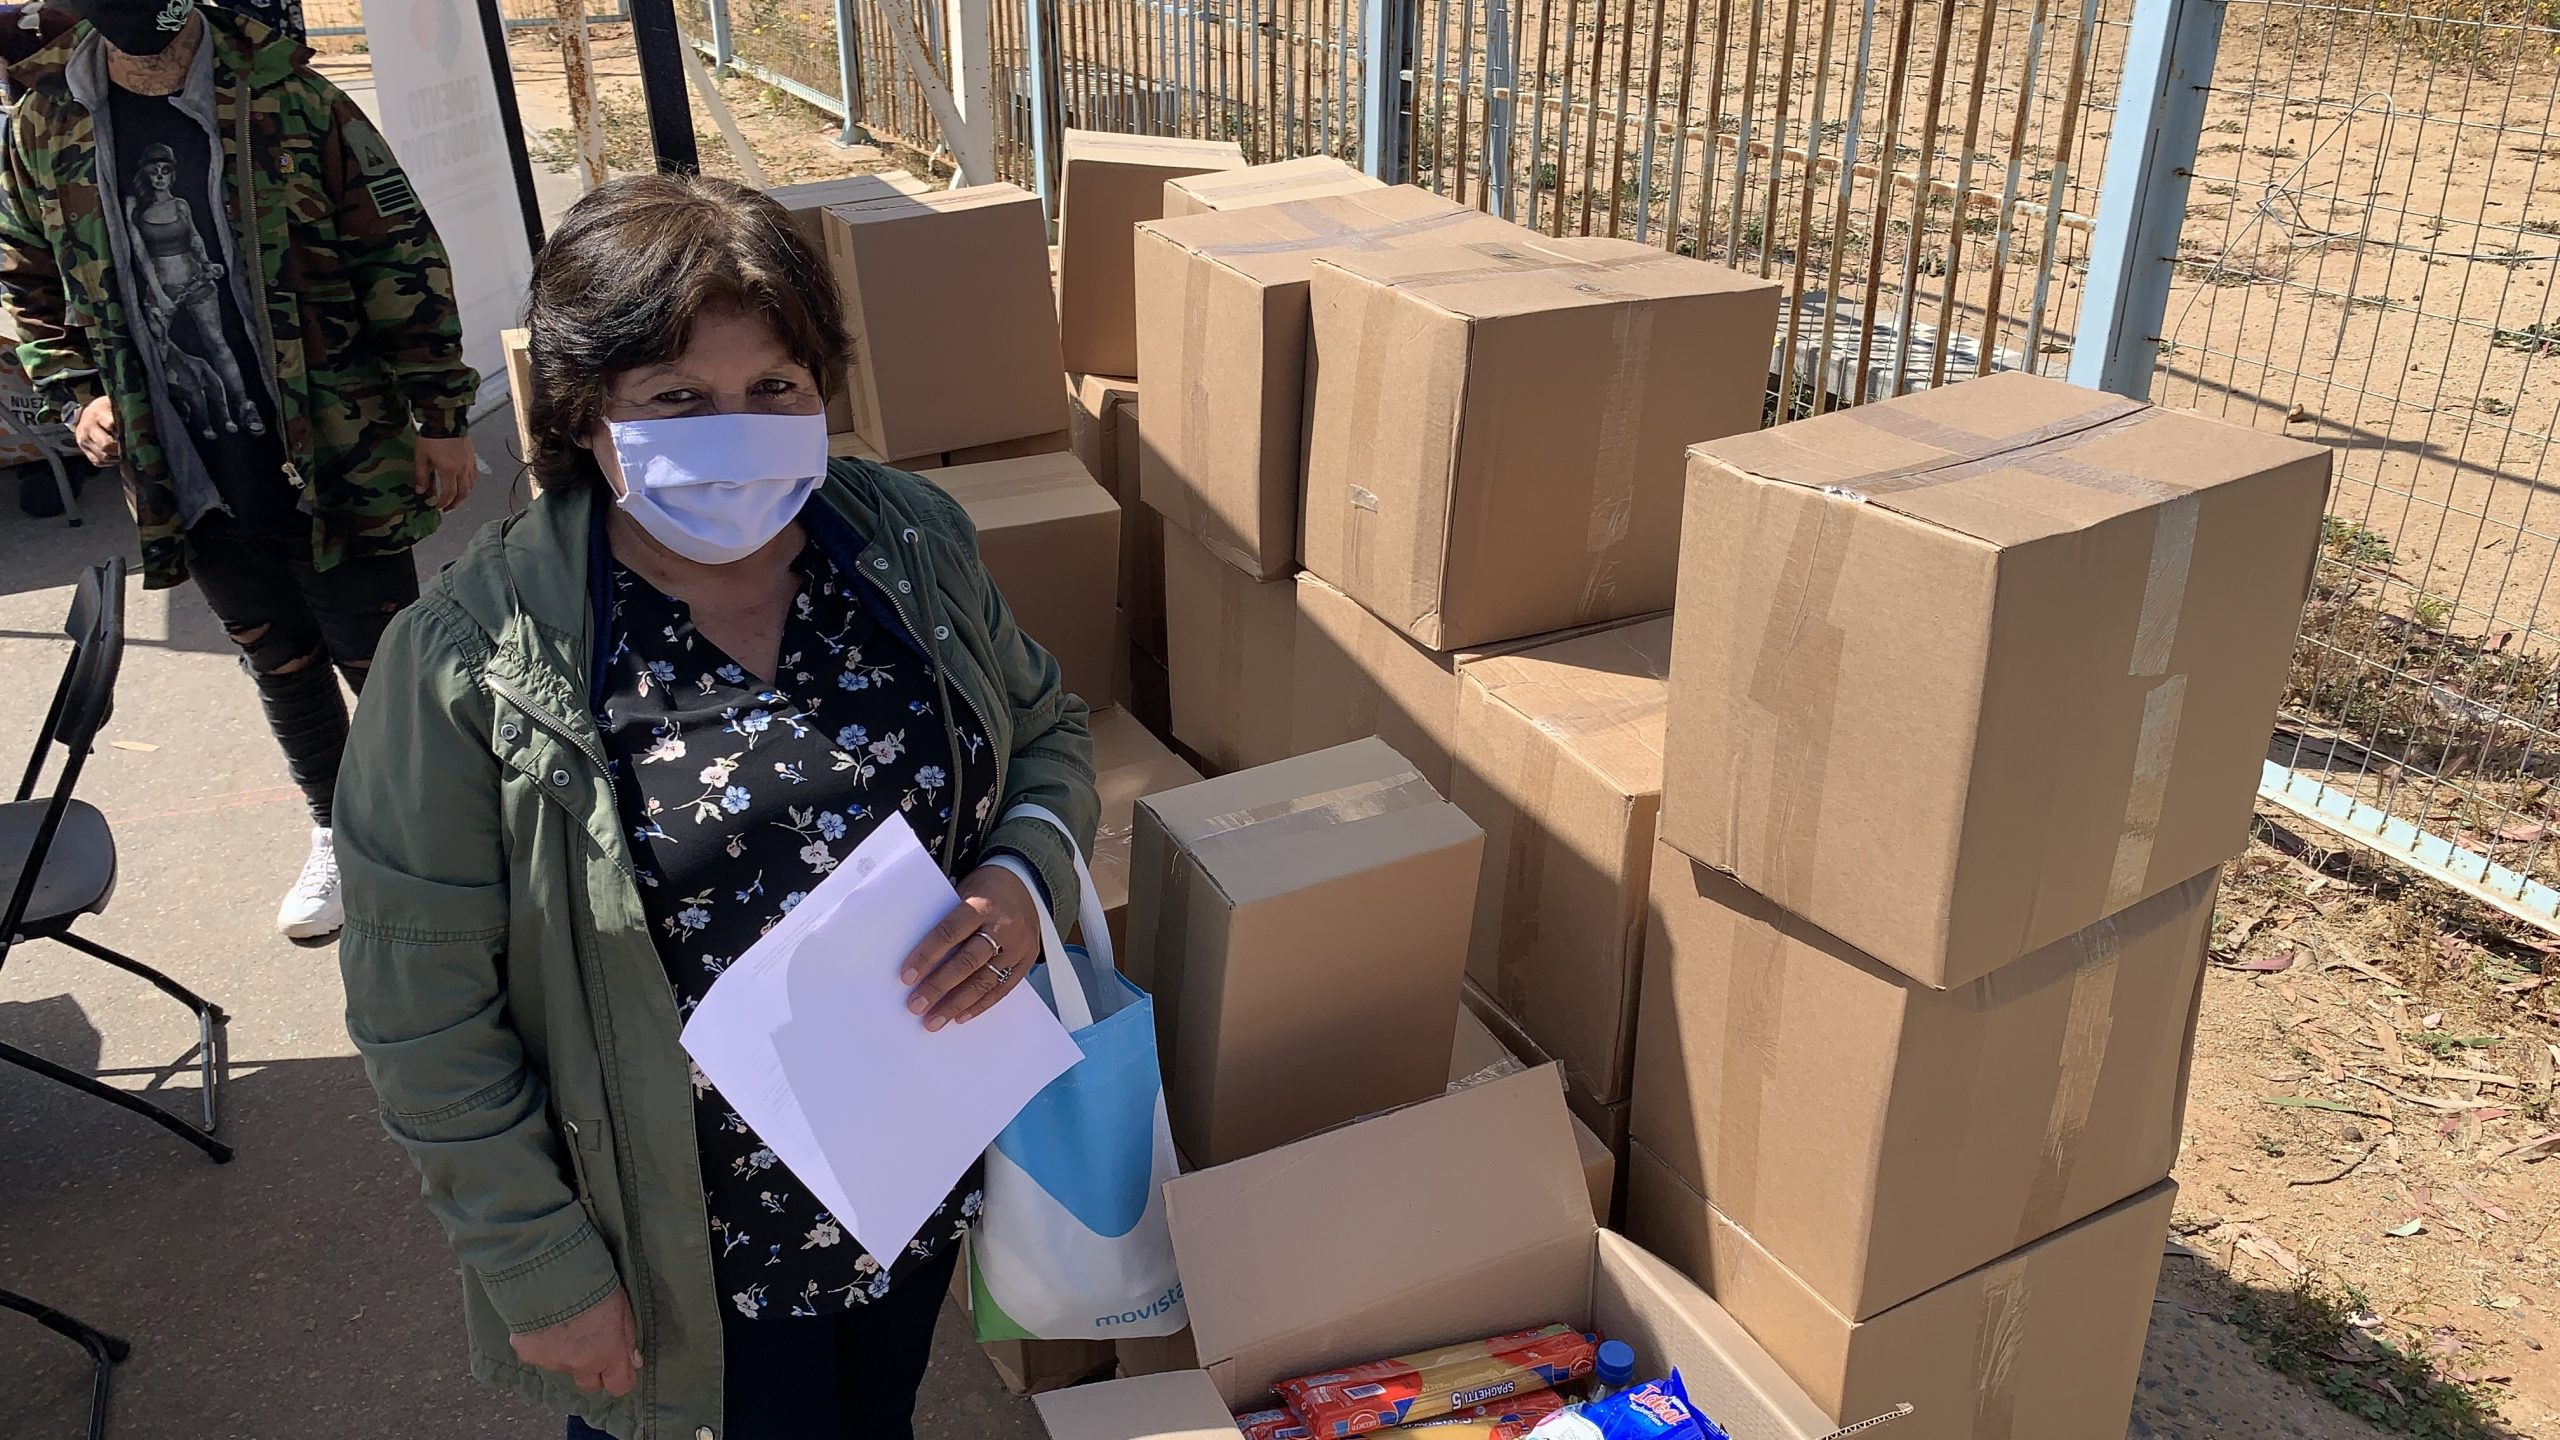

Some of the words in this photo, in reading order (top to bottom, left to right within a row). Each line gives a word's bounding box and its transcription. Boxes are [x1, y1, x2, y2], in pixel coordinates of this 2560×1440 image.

[1096, 1282, 1184, 1327] movista
[1451, 1391, 1463, 1410] 5
[1463, 1380, 1515, 1405] SPAGHETTI
[1629, 1384, 1691, 1426] Ideal
